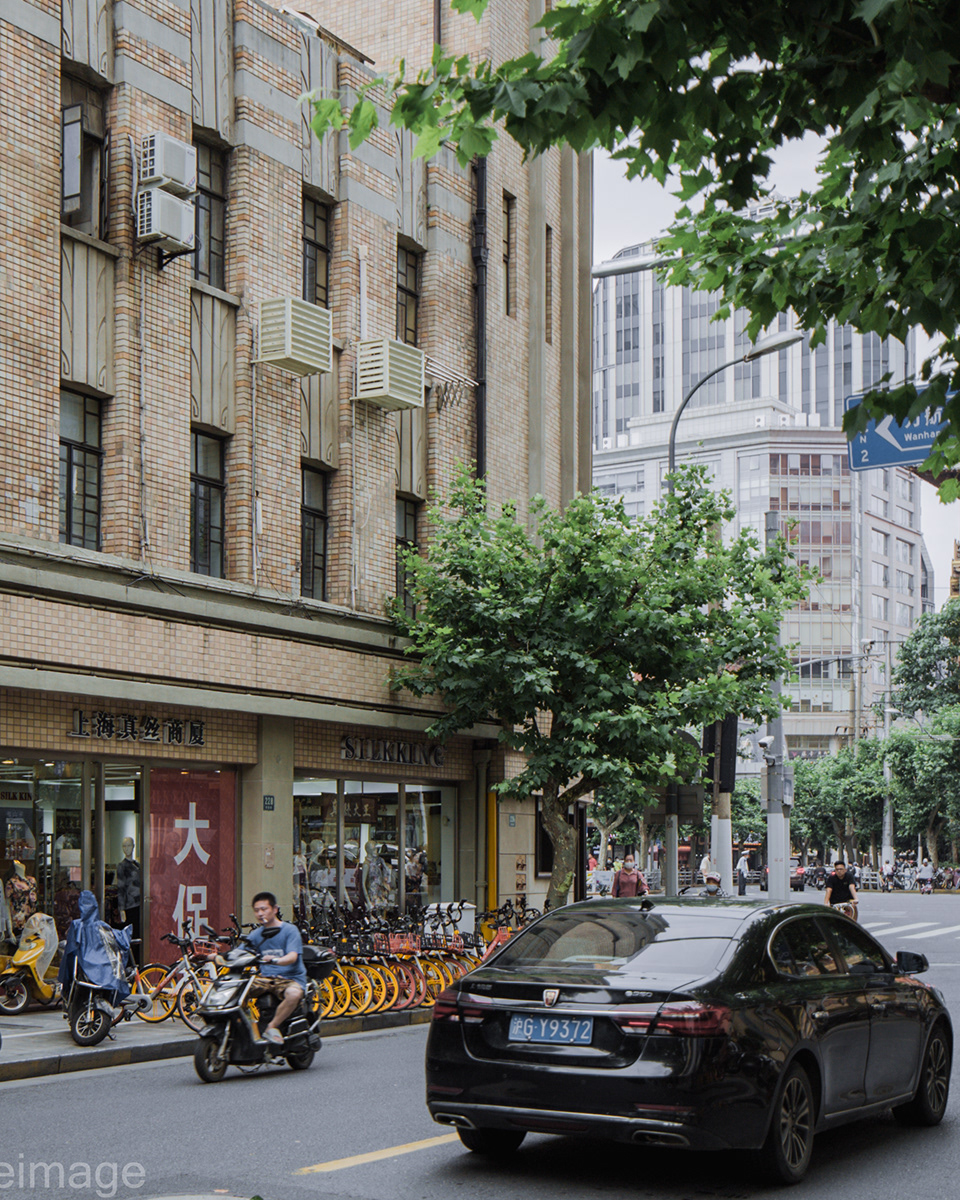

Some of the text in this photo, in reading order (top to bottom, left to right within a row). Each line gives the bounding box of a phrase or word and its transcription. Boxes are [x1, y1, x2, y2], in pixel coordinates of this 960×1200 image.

[859, 435, 867, 444] N
[861, 449, 869, 462] 2
[68, 708, 207, 747] 上海真丝商厦
[0, 791, 18, 801] SILK
